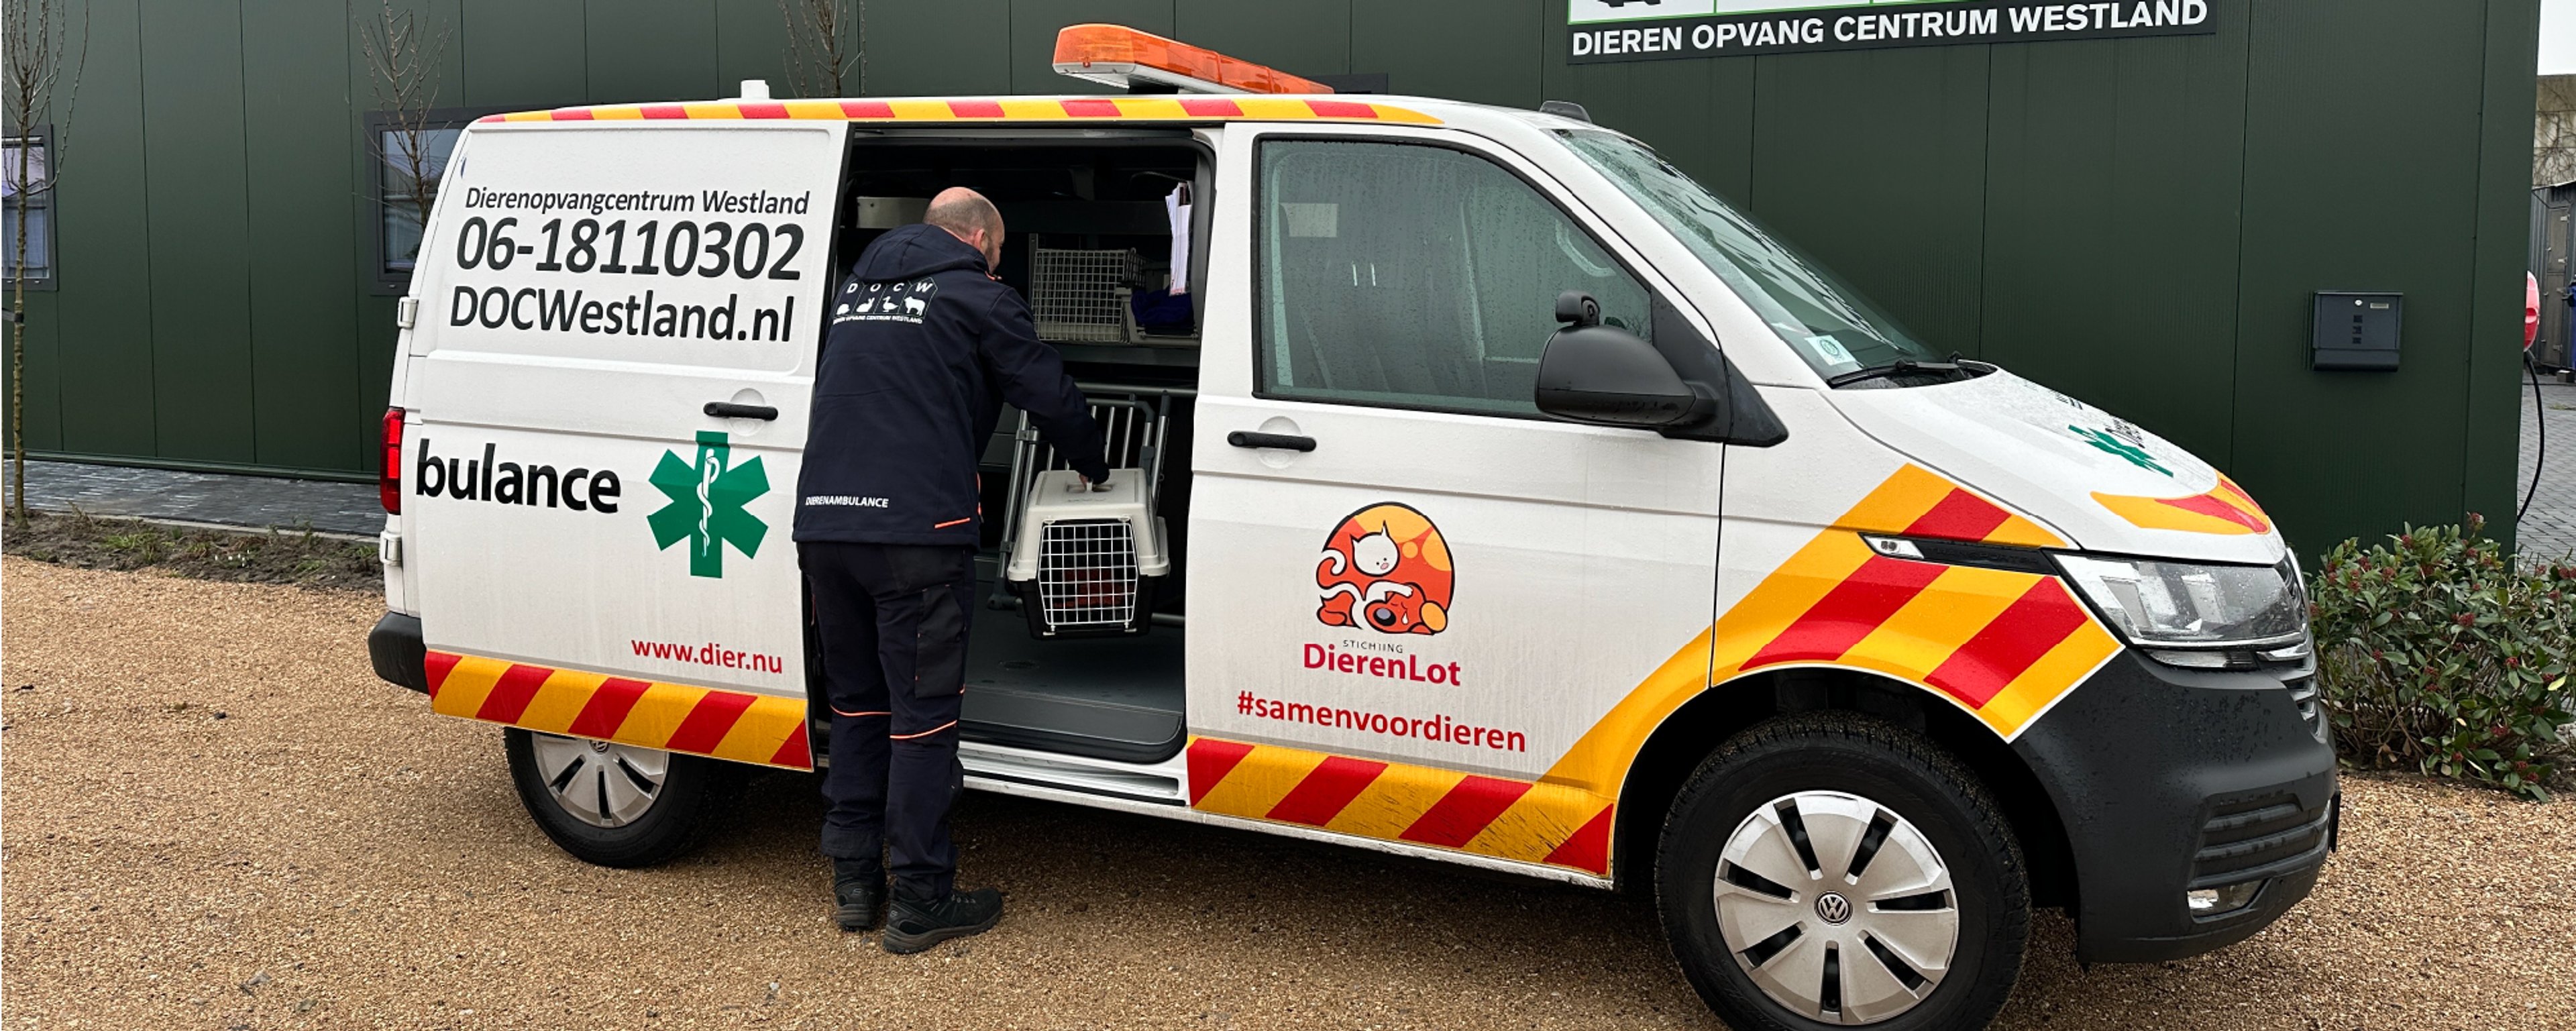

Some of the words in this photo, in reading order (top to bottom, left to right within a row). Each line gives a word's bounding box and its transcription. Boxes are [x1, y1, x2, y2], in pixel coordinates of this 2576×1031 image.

[1572, 26, 1682, 56] DIEREN
[1690, 17, 1825, 50] OPVANG
[1833, 9, 1998, 42] CENTRUM
[2008, 0, 2208, 33] WESTLAND
[465, 187, 696, 216] Dierenopvangcentrum
[702, 189, 810, 215] Westland
[456, 216, 804, 281] 06-18110302
[450, 286, 794, 343] DOCWestland.nl
[416, 438, 621, 514] bulance
[631, 641, 783, 674] www.dier.nu
[1303, 643, 1461, 687] DierenLot
[1237, 691, 1526, 753] #samenvoordieren
